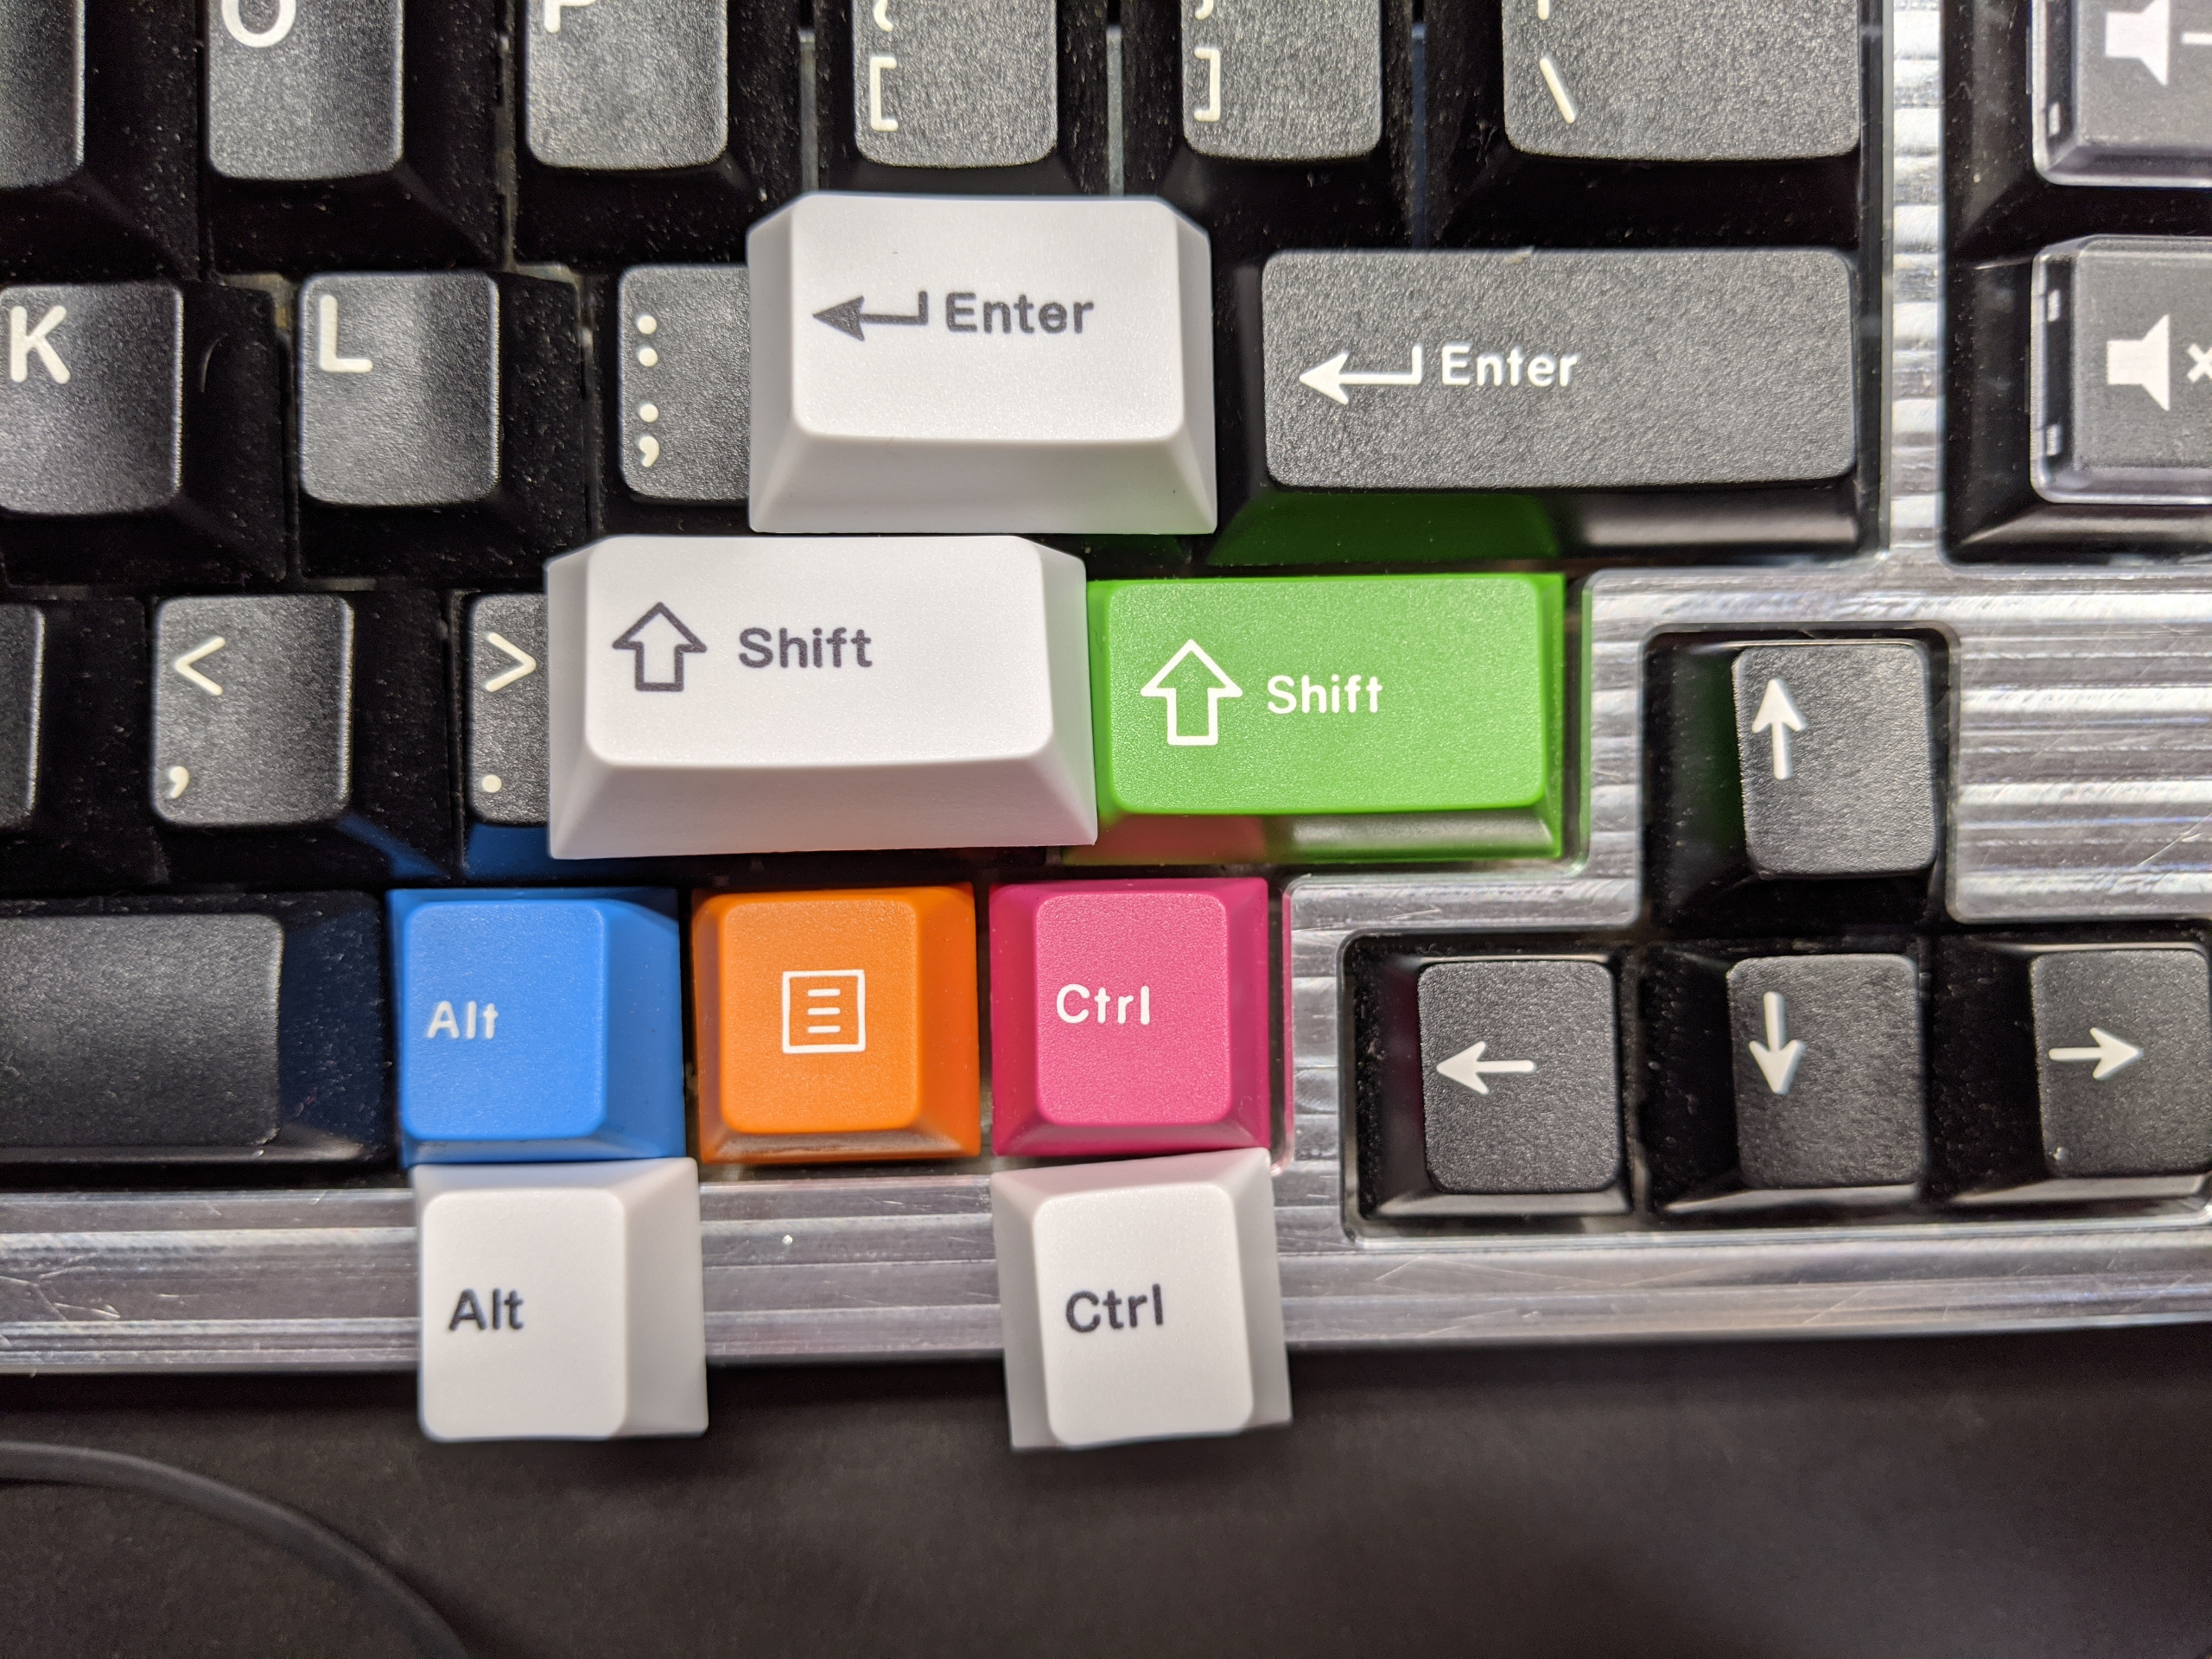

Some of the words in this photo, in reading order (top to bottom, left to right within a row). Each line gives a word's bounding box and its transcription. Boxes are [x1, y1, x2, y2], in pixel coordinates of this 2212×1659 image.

[317, 294, 374, 373] L
[944, 290, 1096, 335] Enter
[10, 304, 71, 385] K
[1440, 344, 1580, 387] Enter
[737, 626, 874, 670] Shift
[1266, 674, 1384, 715] Shift
[425, 1000, 499, 1040] Alt
[1055, 982, 1152, 1027] Ctrl
[447, 1287, 524, 1332] Alt
[1064, 1282, 1165, 1335] Ctrl
